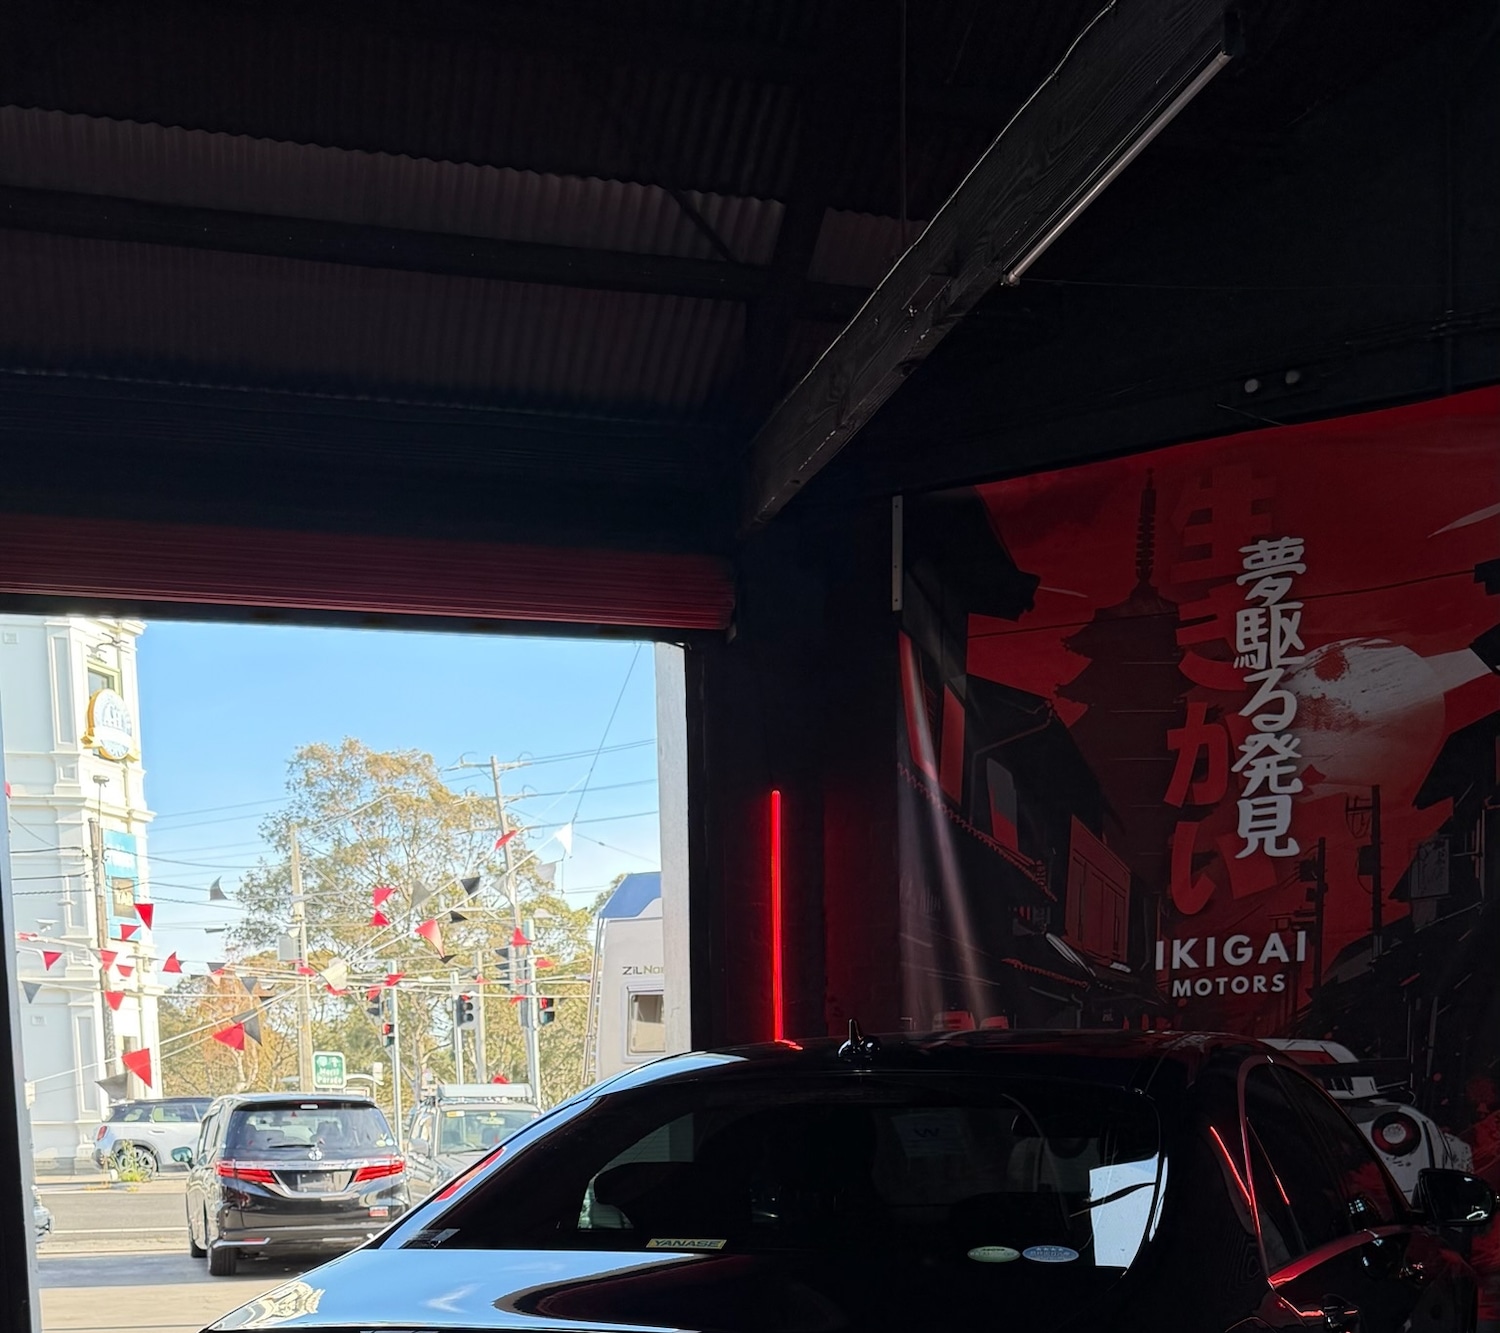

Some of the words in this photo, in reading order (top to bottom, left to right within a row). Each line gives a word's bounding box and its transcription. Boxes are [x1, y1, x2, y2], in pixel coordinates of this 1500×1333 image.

[1231, 535, 1307, 860] 夢駆る発見
[1155, 930, 1306, 971] IKIGAI
[1172, 974, 1285, 998] MOTORS
